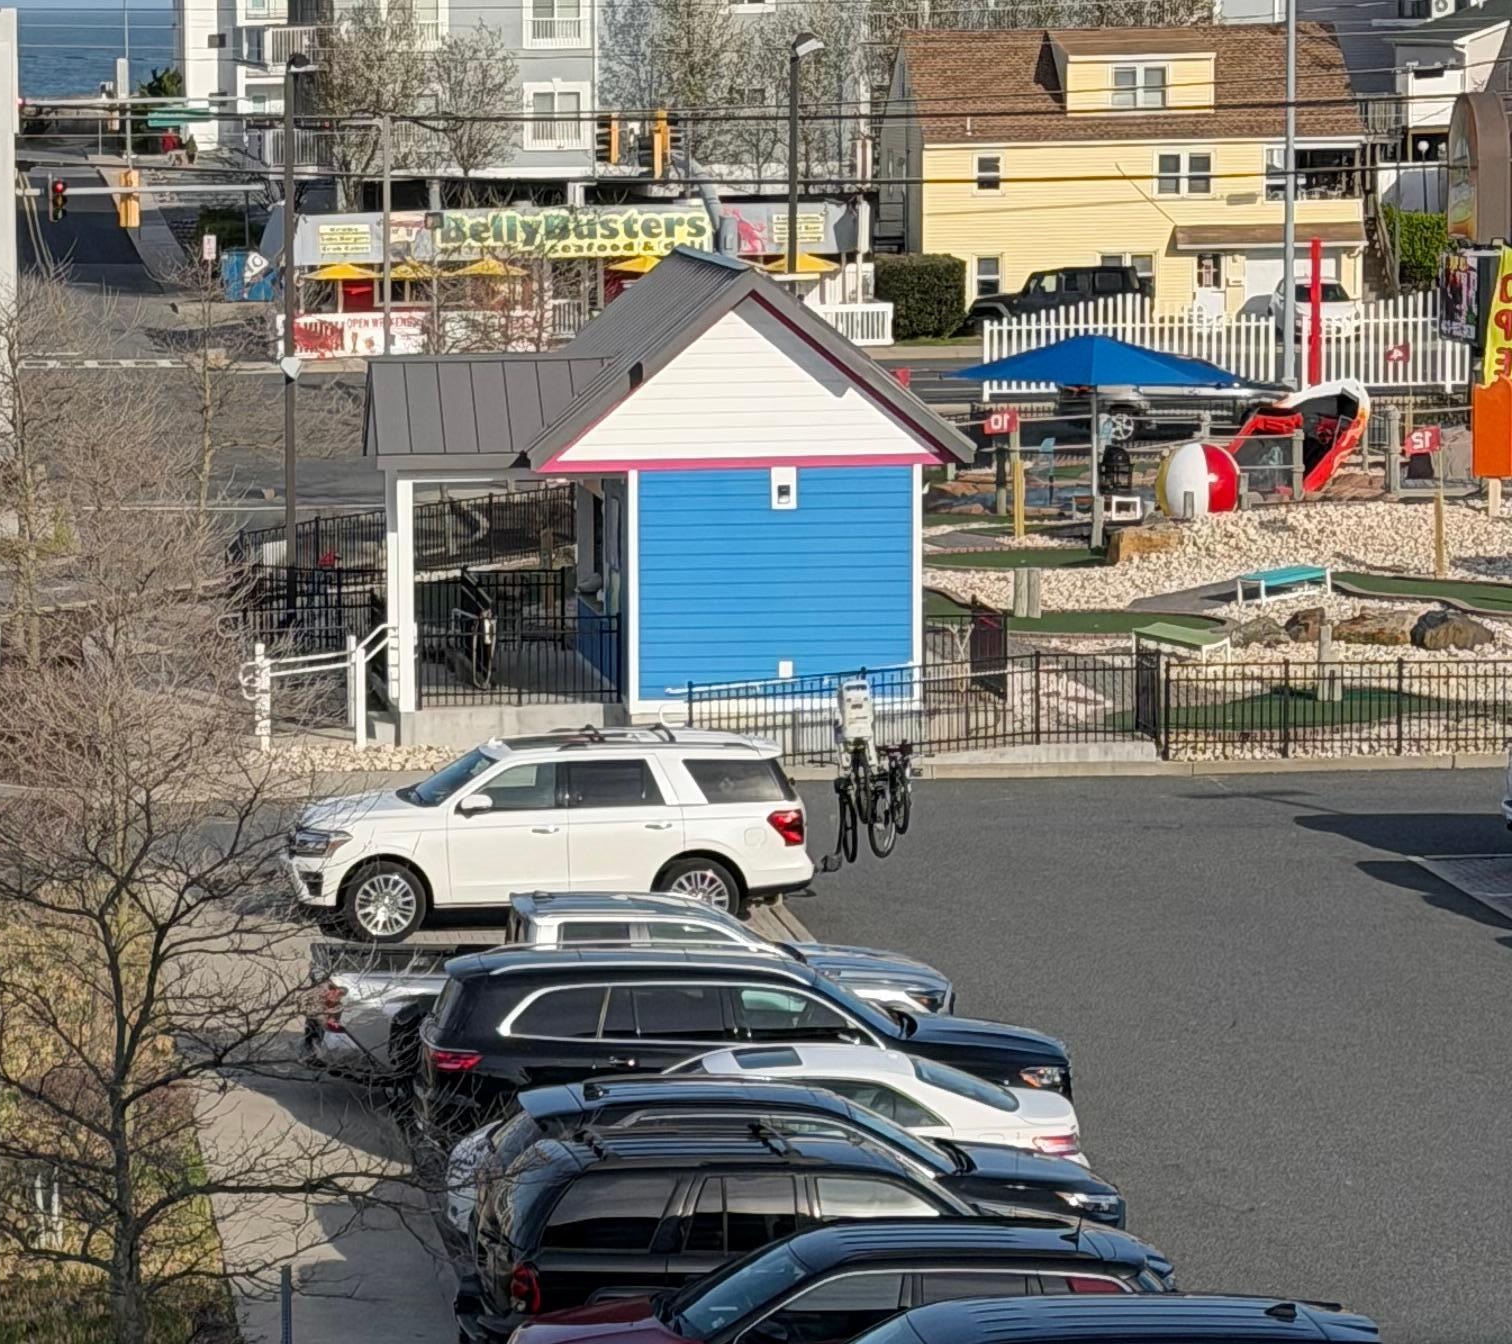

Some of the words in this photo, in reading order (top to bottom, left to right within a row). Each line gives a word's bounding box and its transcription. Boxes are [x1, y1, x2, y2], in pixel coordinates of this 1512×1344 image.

[440, 213, 706, 246] BellyBusters
[642, 240, 654, 251] &
[664, 240, 704, 250] dli
[347, 318, 369, 328] OPEN
